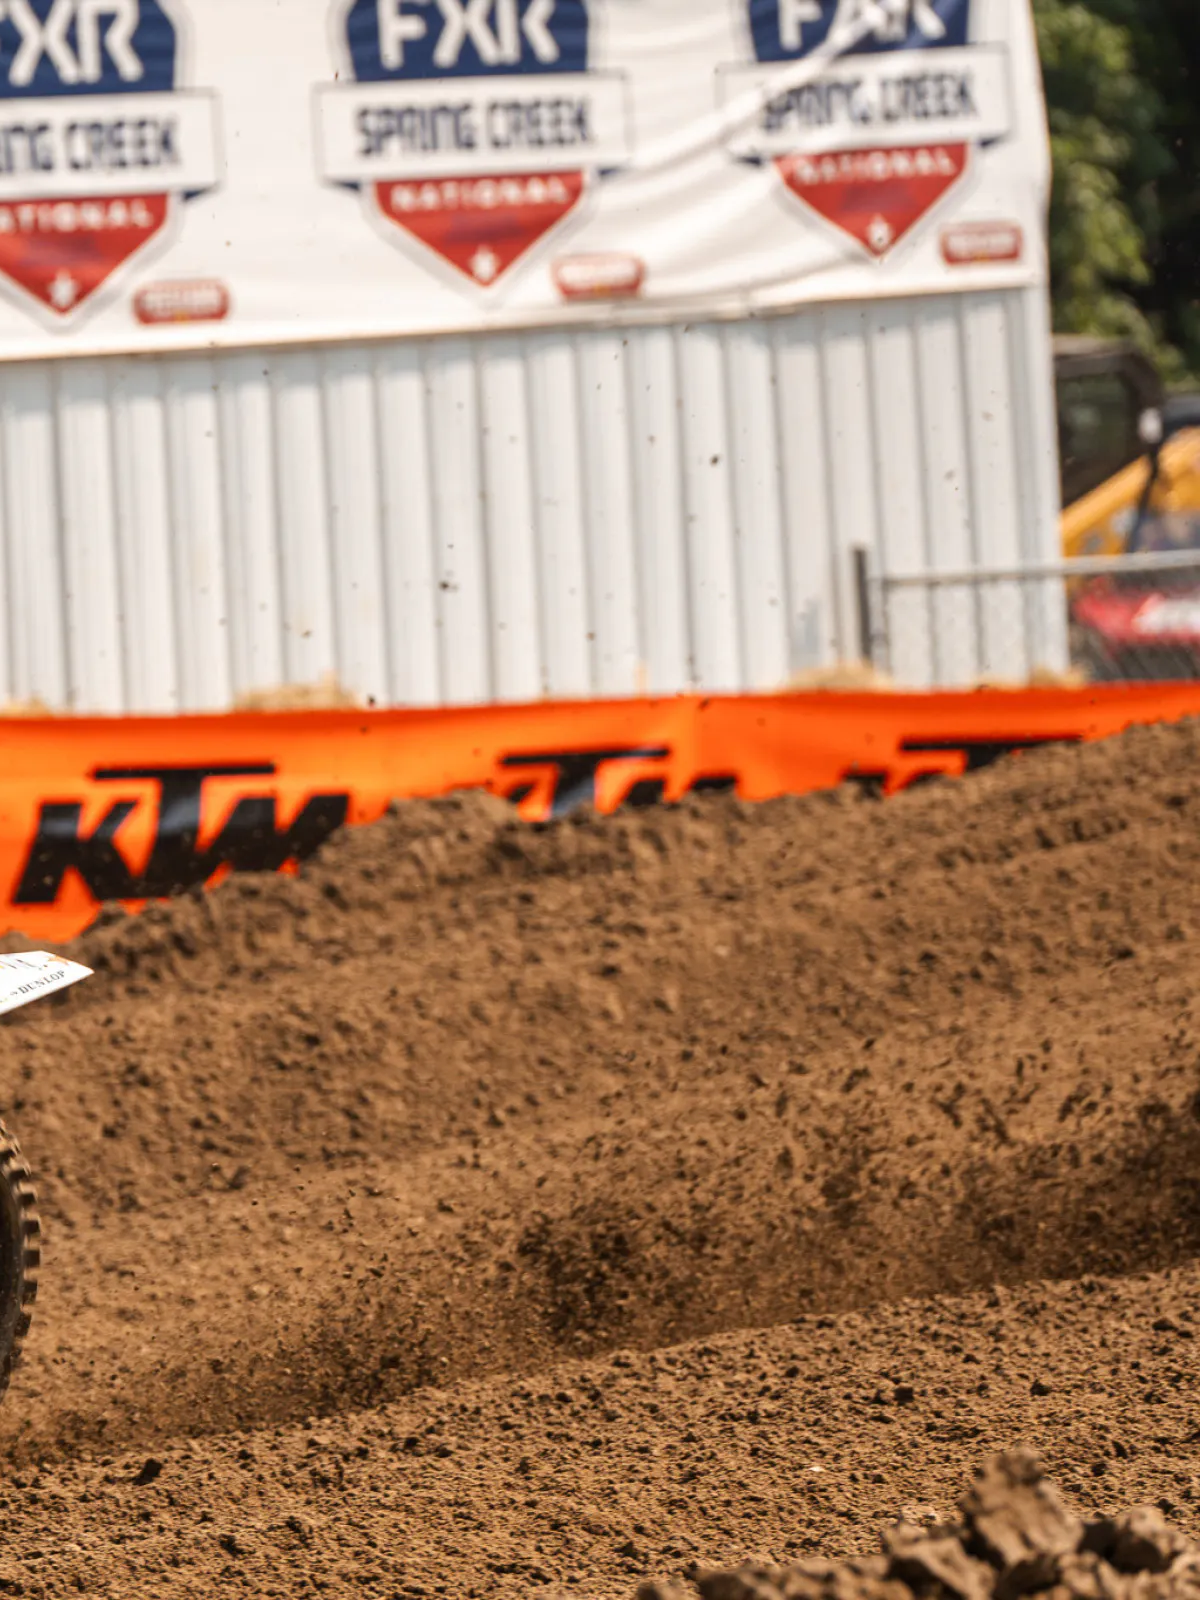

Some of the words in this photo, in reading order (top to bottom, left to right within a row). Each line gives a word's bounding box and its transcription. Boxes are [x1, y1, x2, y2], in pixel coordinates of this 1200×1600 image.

[881, 68, 980, 124] CREEK
[65, 115, 182, 172] CREEK
[356, 103, 478, 157] SPRING
[487, 96, 591, 149] CREEK
[12, 763, 350, 904] KTM
